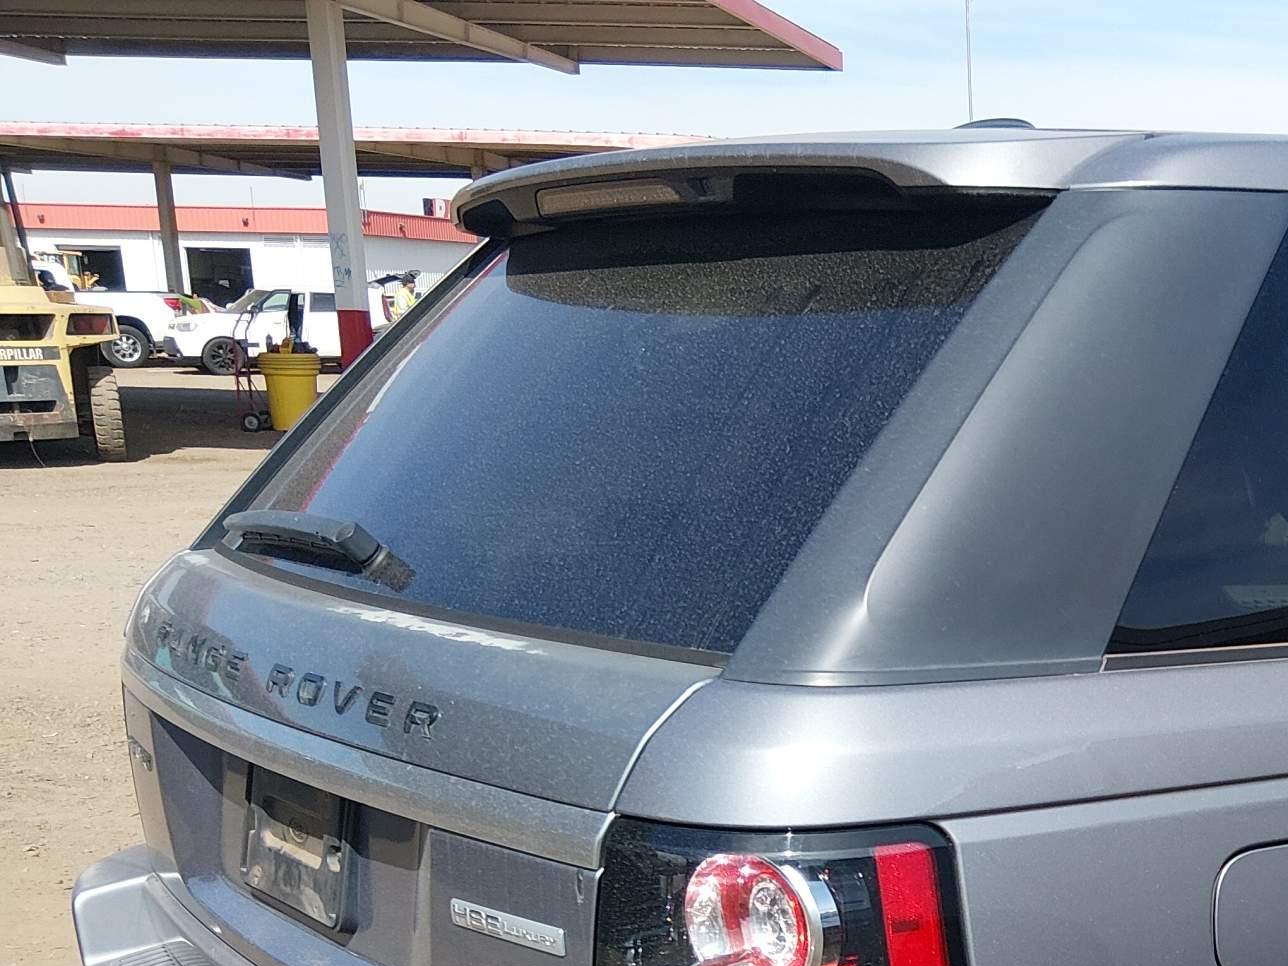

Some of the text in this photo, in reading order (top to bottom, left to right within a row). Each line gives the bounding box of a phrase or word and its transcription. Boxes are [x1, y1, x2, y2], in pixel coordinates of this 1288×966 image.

[156, 620, 442, 742] RANGE ROVER
[452, 902, 503, 936] HSE
